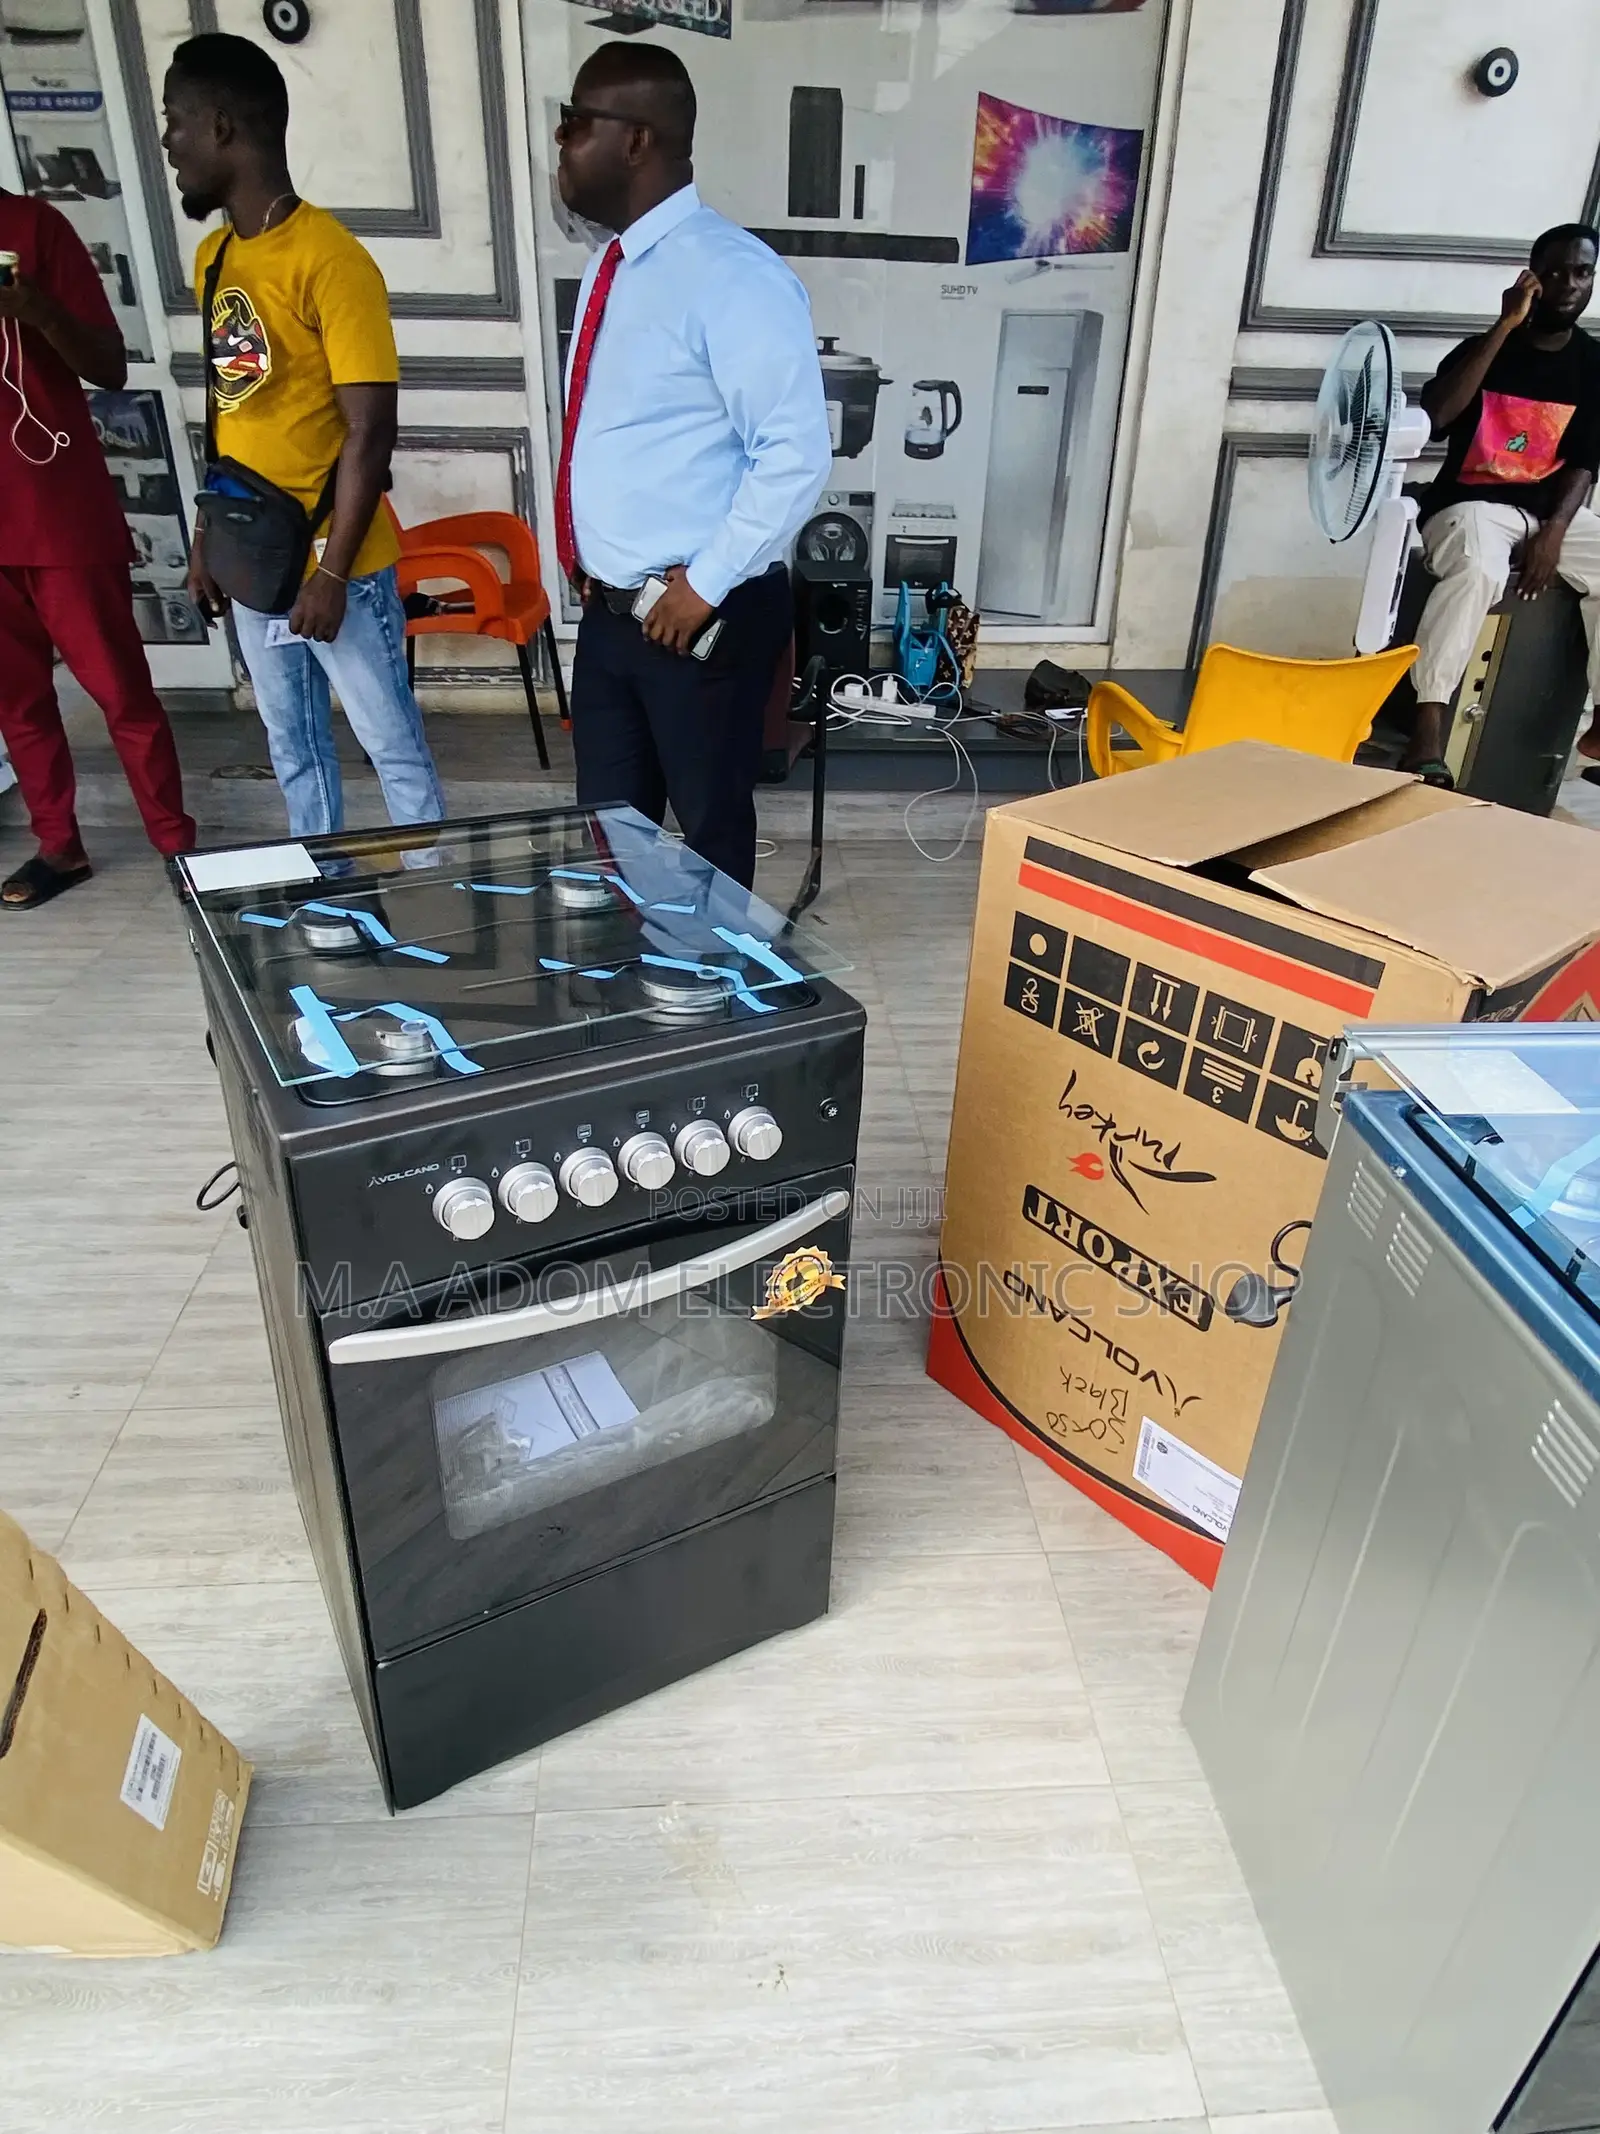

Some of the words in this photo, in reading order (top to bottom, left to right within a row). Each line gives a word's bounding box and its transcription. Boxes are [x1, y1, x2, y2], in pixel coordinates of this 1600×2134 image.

[967, 285, 979, 295] TV
[1211, 1086, 1225, 1105] 3
[378, 1163, 440, 1184] VOLCANO
[1025, 1191, 1203, 1326] EXPORT
[1003, 1270, 1164, 1397] VOLCANO
[1060, 1366, 1129, 1418] Black
